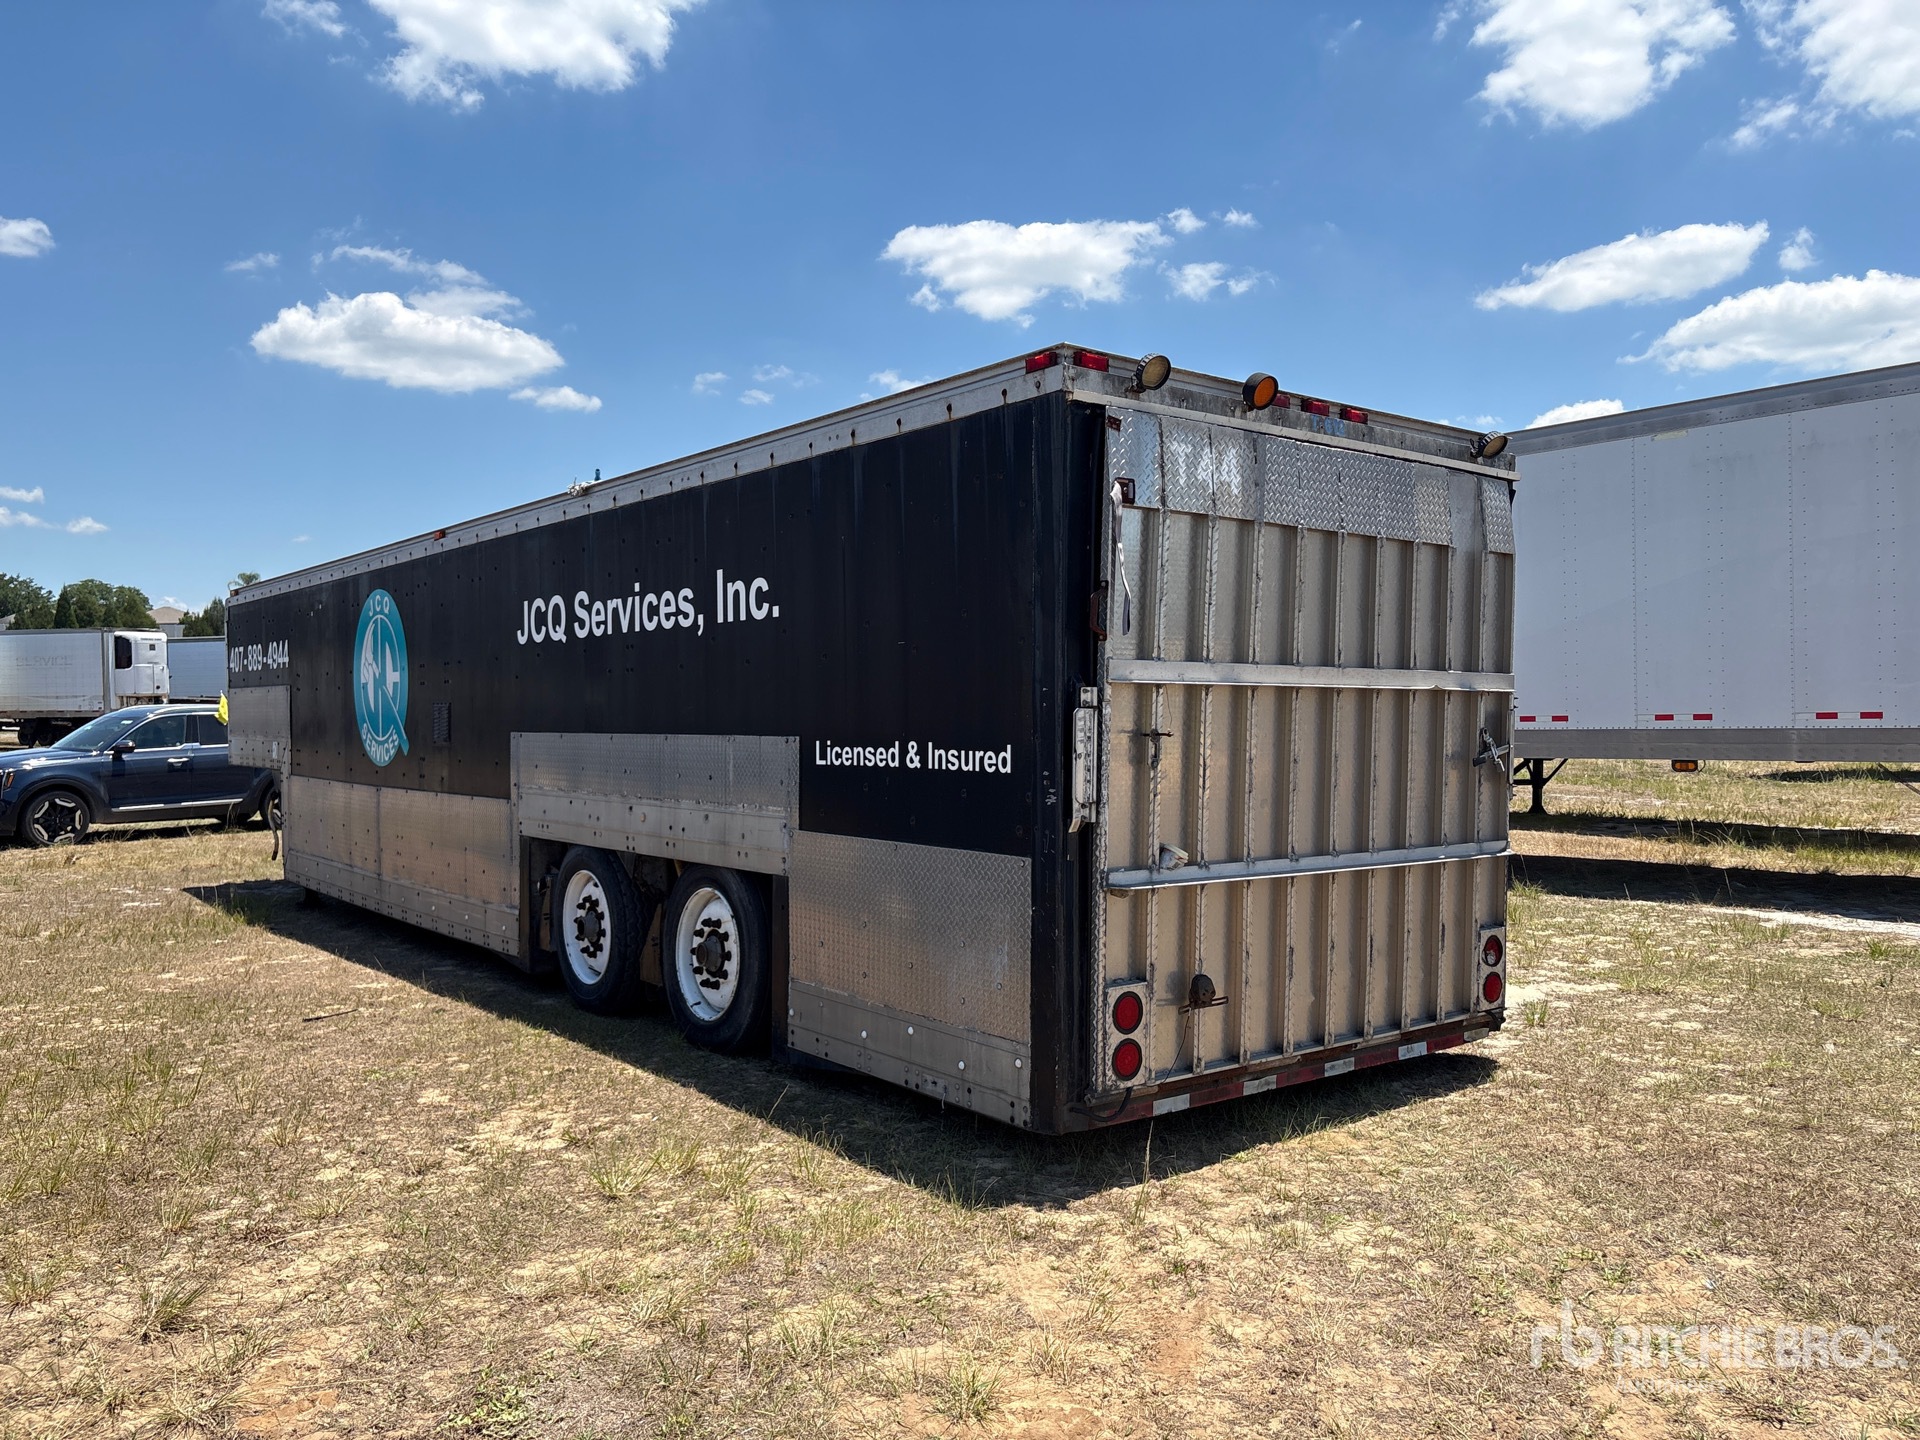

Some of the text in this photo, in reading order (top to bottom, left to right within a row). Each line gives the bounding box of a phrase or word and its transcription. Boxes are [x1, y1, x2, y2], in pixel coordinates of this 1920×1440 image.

[368, 595, 390, 617] JCQ
[517, 569, 780, 645] JCQ Services, Inc.
[229, 639, 290, 673] 407-889-4944
[362, 723, 399, 762] SERVICES
[815, 740, 1012, 774] Licensed & Insured
